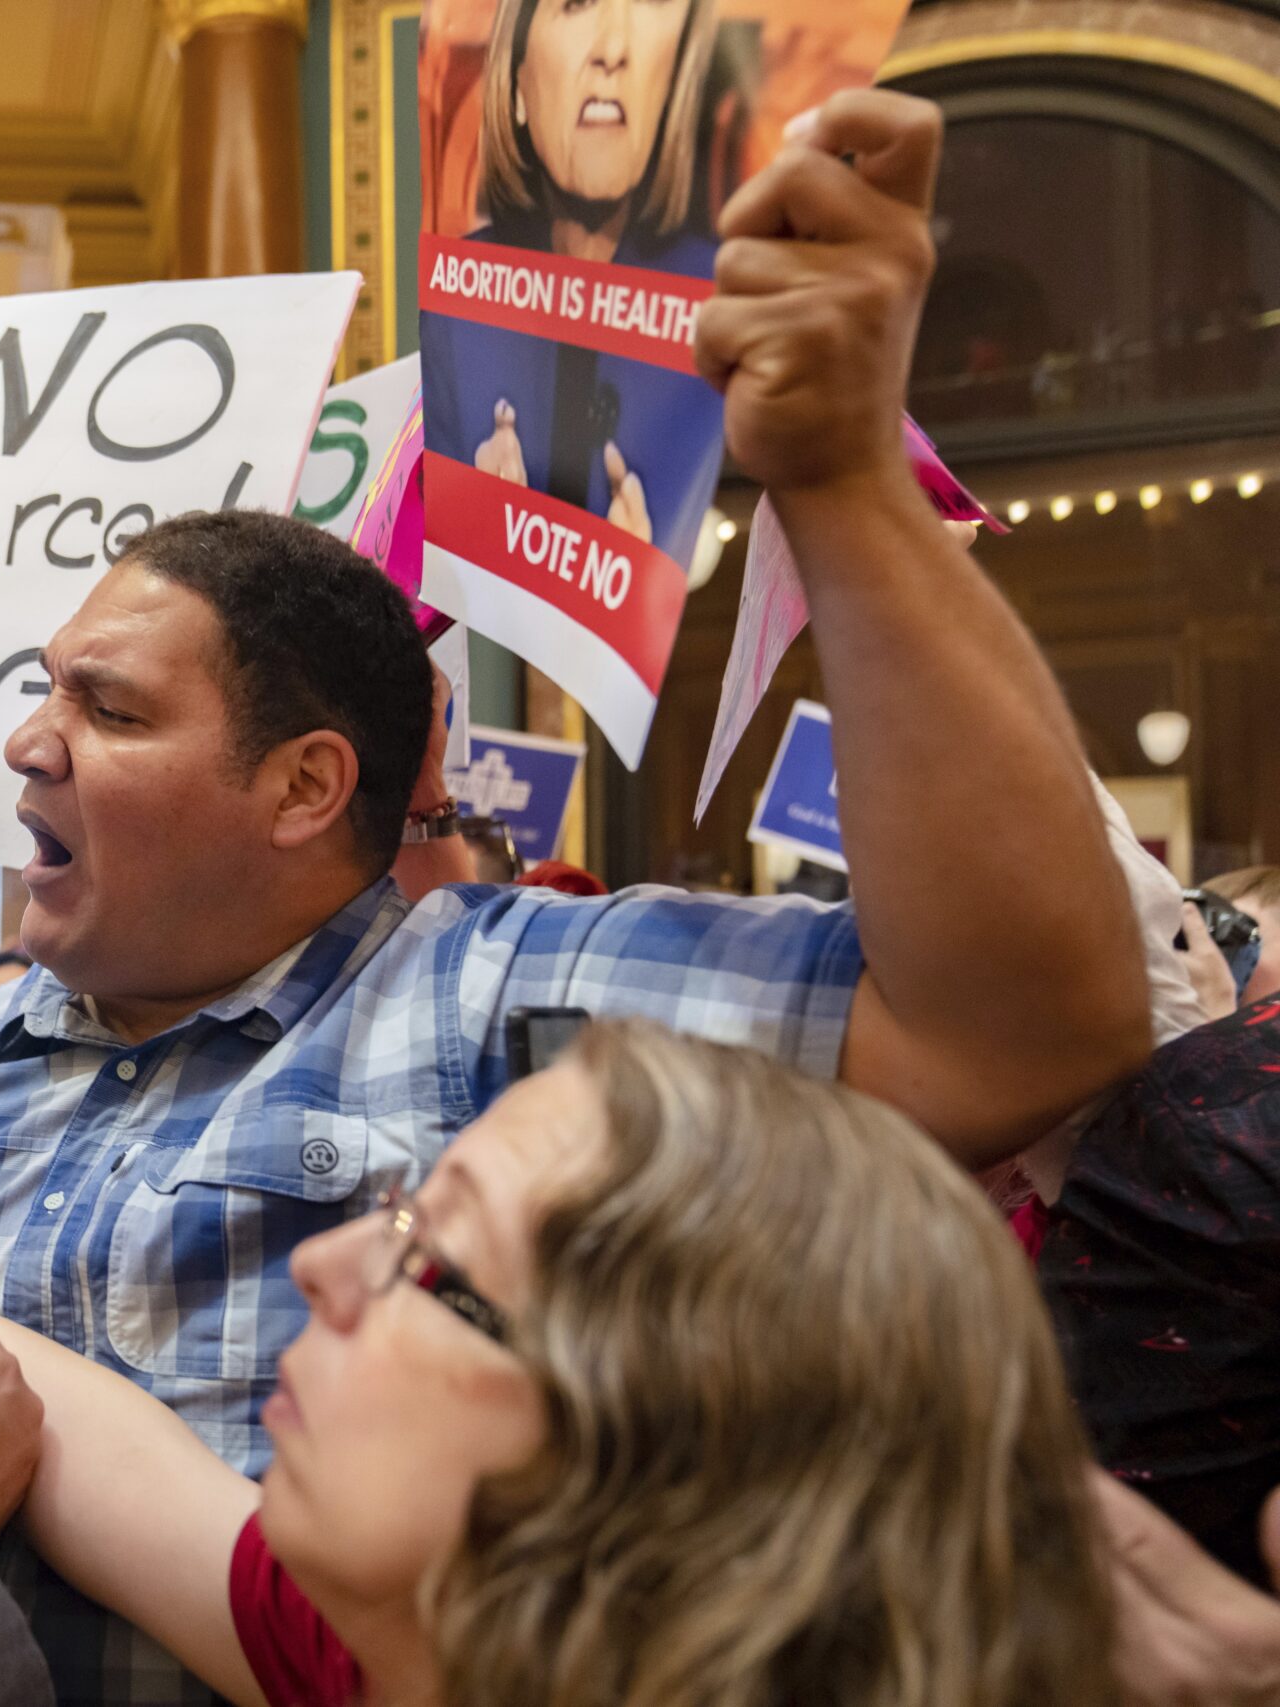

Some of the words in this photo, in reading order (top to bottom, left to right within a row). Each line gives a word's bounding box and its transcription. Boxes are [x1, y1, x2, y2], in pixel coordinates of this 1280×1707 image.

[429, 252, 555, 315] ABORTION
[559, 276, 586, 321] IS
[589, 282, 701, 347] HEALTH
[504, 502, 582, 583] VOTE
[578, 539, 632, 611] NO
